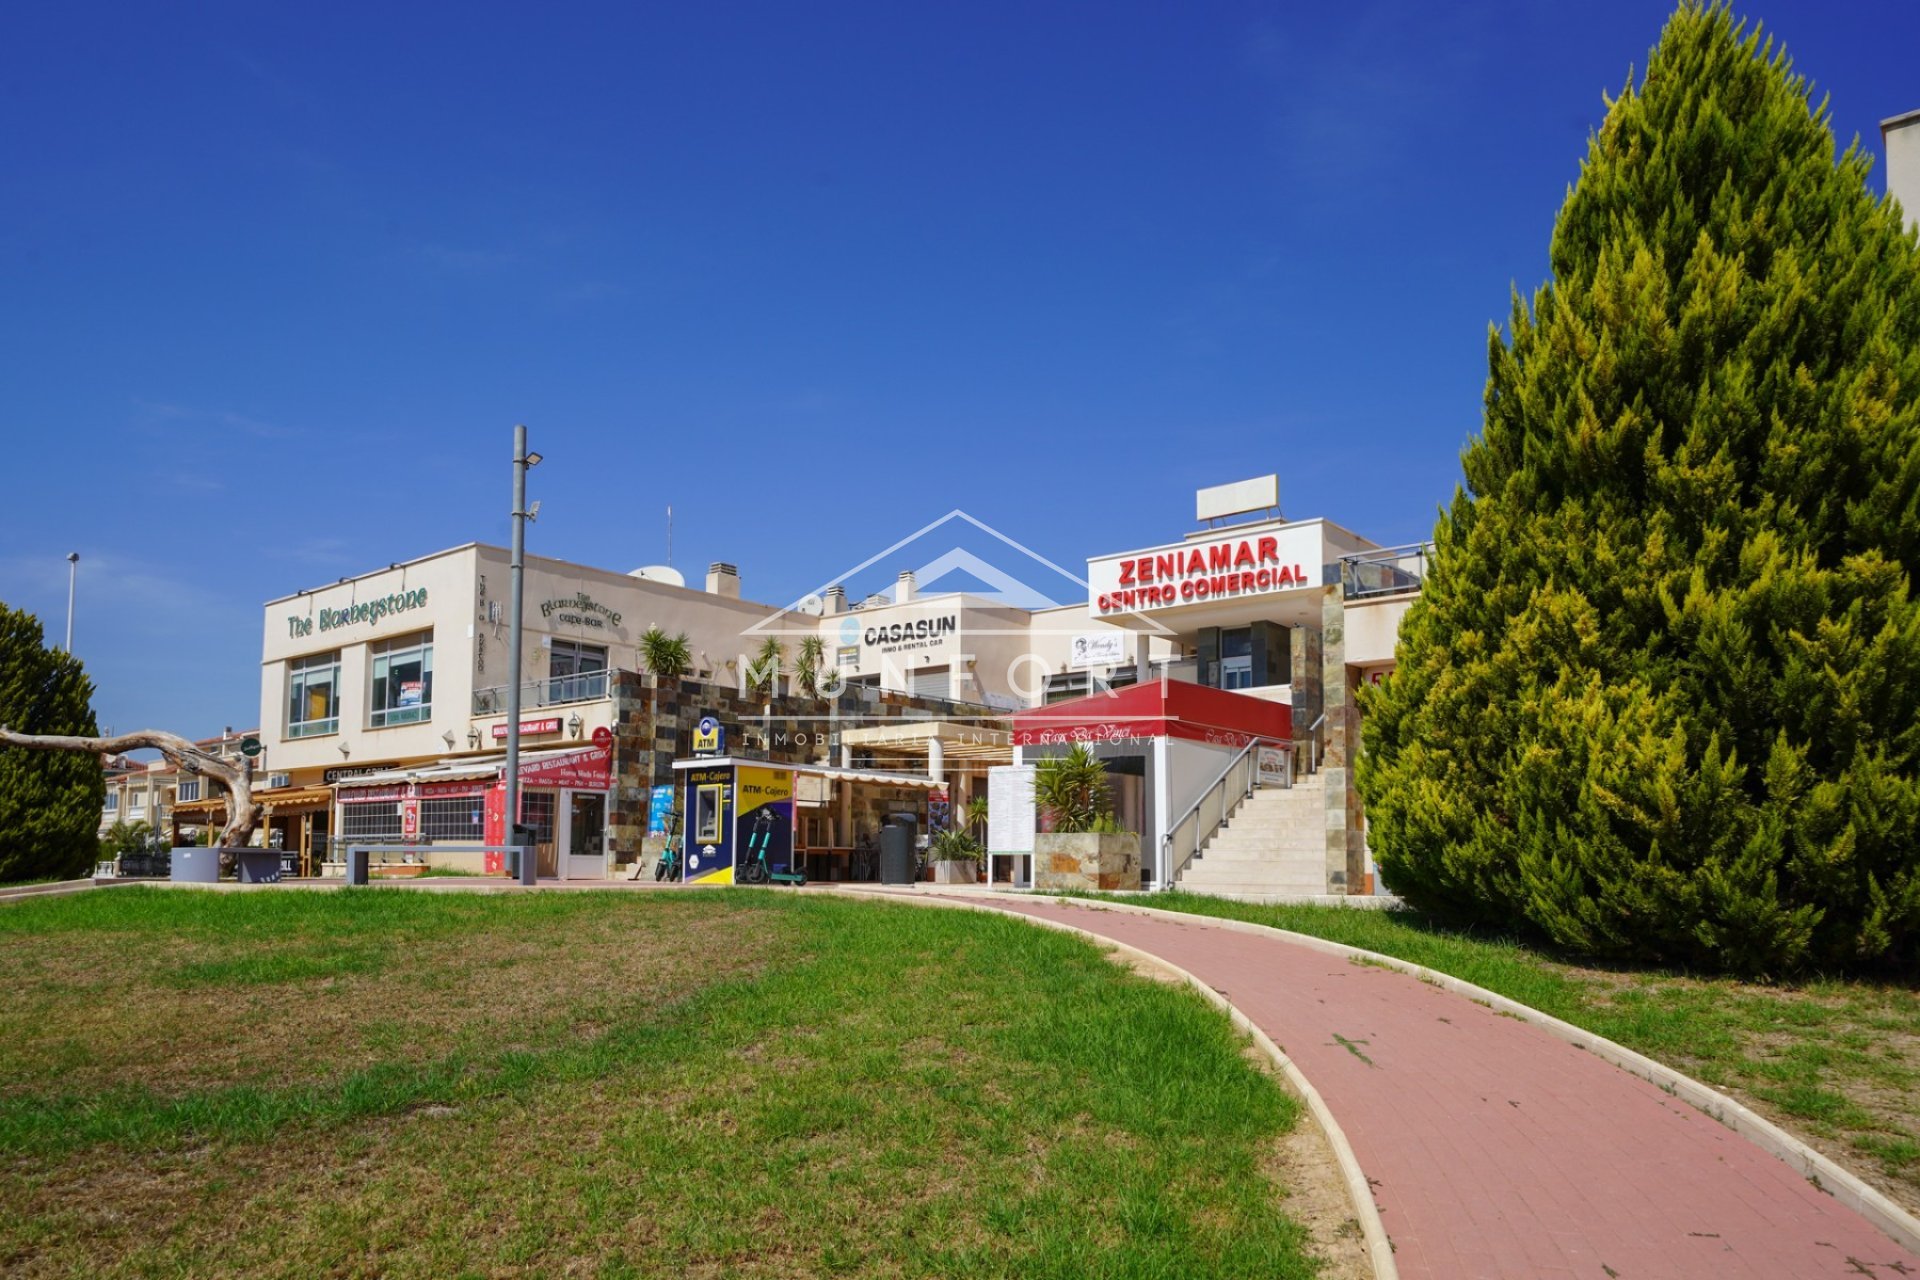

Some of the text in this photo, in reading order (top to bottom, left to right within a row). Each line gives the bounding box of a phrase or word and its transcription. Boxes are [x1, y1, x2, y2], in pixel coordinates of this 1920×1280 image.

[1118, 537, 1279, 585] ZENIAMAR
[1098, 565, 1308, 610] CENTRO COMERCIAL
[288, 587, 428, 639] The Blarneystone
[864, 615, 956, 646] CASASUN
[881, 645, 897, 654] INMO
[903, 639, 928, 651] RENTAL
[929, 638, 943, 647] CAR
[1087, 637, 1118, 652] Wendy's
[697, 738, 714, 748] ATM
[326, 768, 363, 782] CENTRAL
